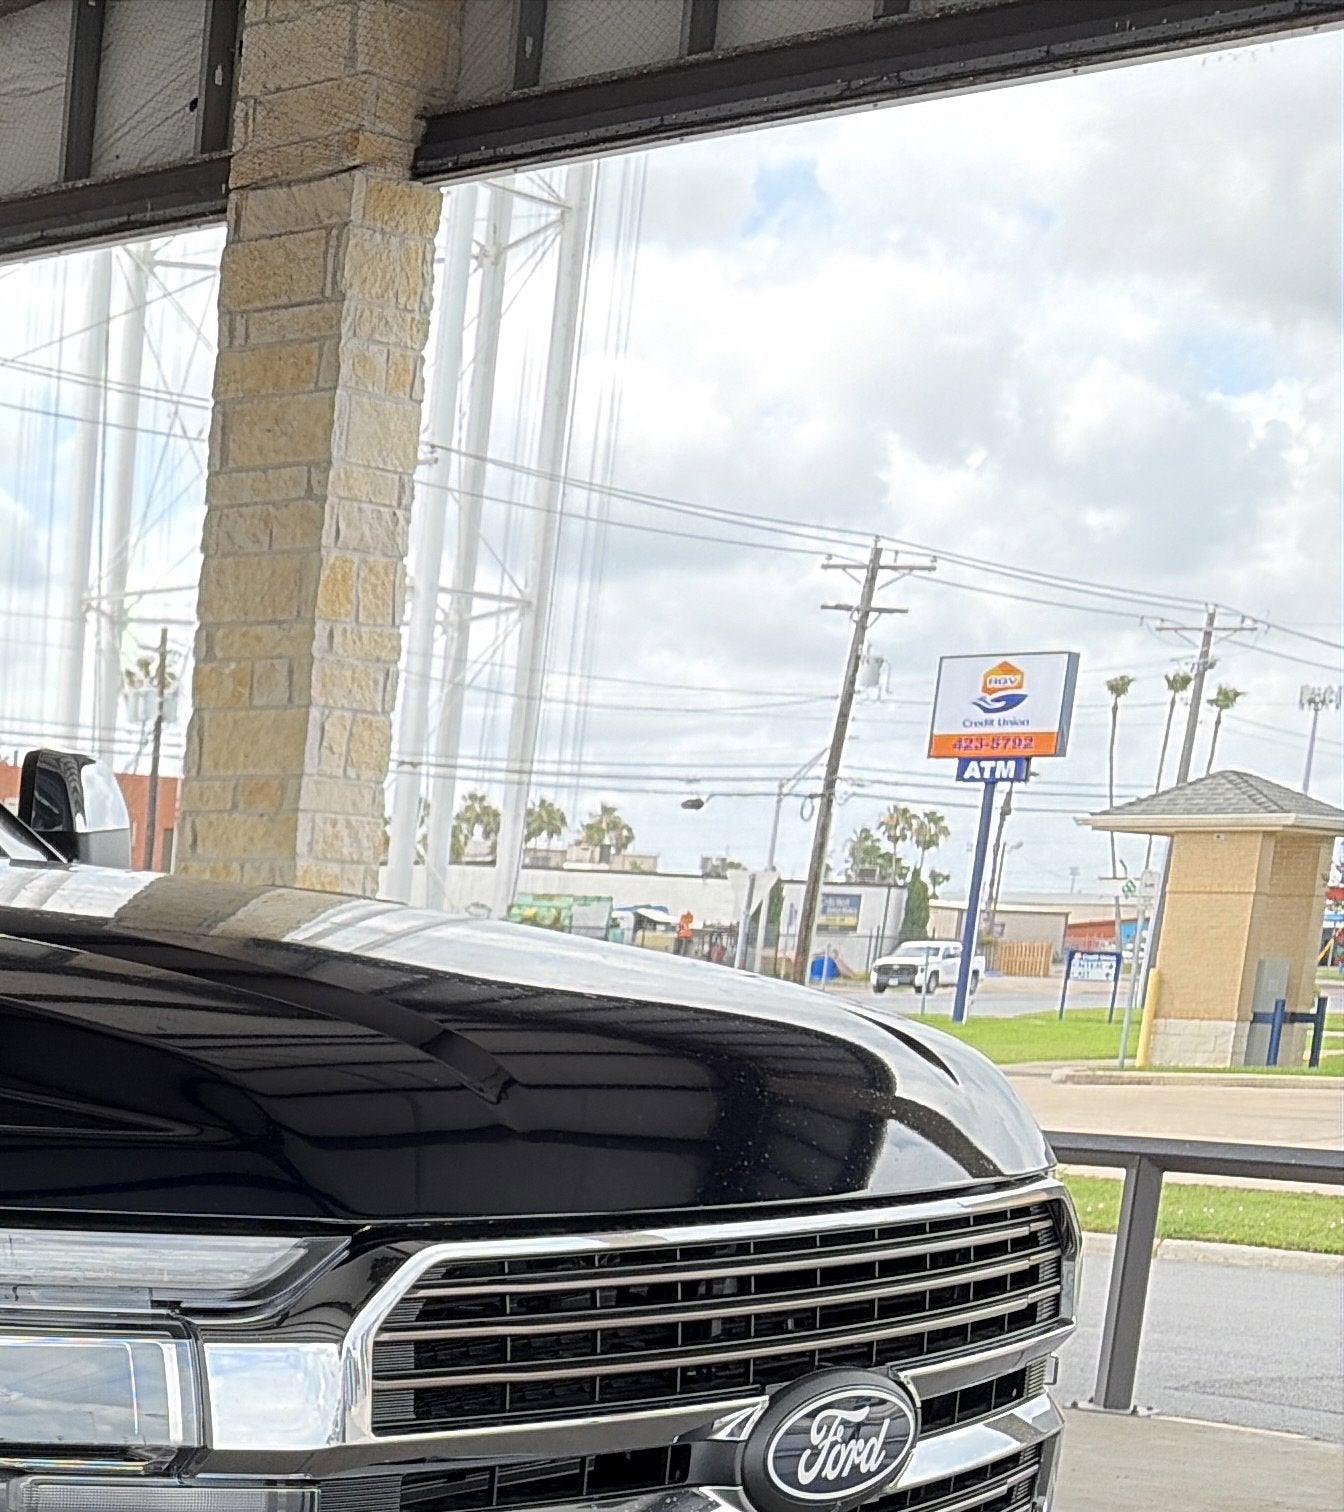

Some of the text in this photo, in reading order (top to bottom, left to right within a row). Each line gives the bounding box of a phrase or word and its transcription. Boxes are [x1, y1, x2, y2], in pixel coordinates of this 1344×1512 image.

[962, 718, 1030, 728] Credit Union
[963, 761, 1016, 779] ATM
[797, 1405, 890, 1486] Ford
